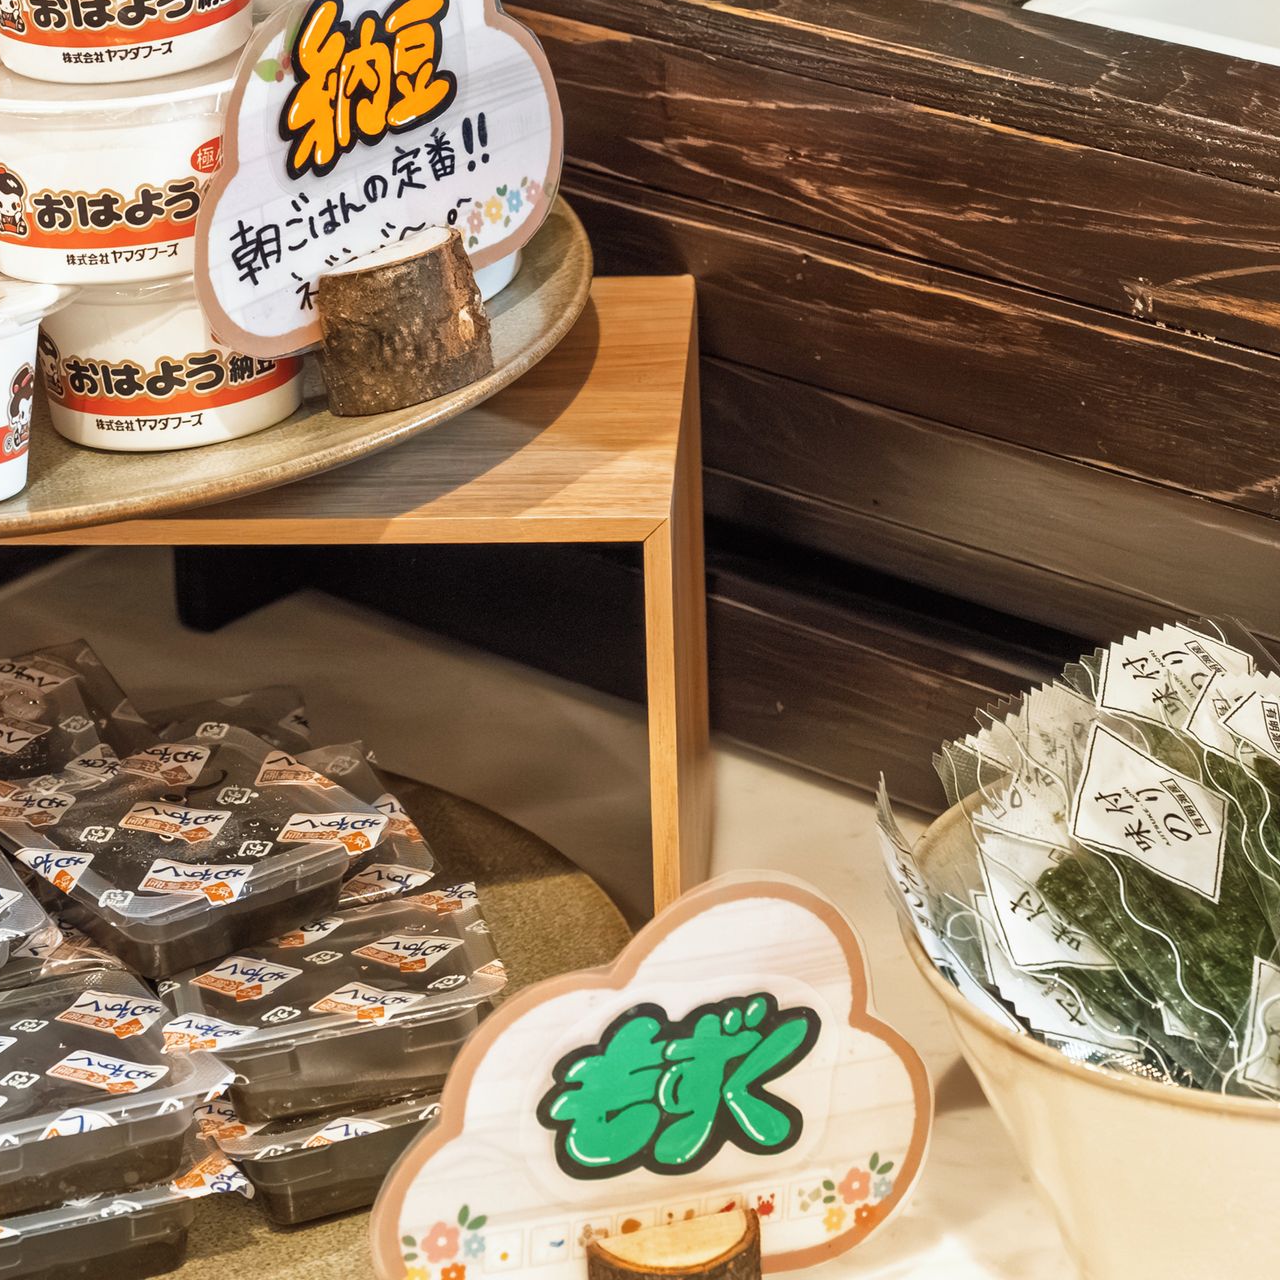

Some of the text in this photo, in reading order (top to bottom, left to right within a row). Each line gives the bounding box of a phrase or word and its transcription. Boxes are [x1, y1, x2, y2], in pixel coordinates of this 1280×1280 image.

[62, 40, 174, 65] 株式会社ヤマダフーズ
[66, 243, 180, 266] 株式会社ヤマダフーズ
[96, 413, 204, 432] 株式会社ヤマダフーズ
[133, 806, 225, 826] もずく
[290, 816, 383, 831] もずく
[1093, 791, 1157, 853] 味付
[1136, 787, 1193, 842] のり
[153, 866, 246, 881] もずく
[75, 1000, 161, 1018] もずく
[68, 1056, 157, 1078] もずく
[536, 991, 822, 1181] もずく
